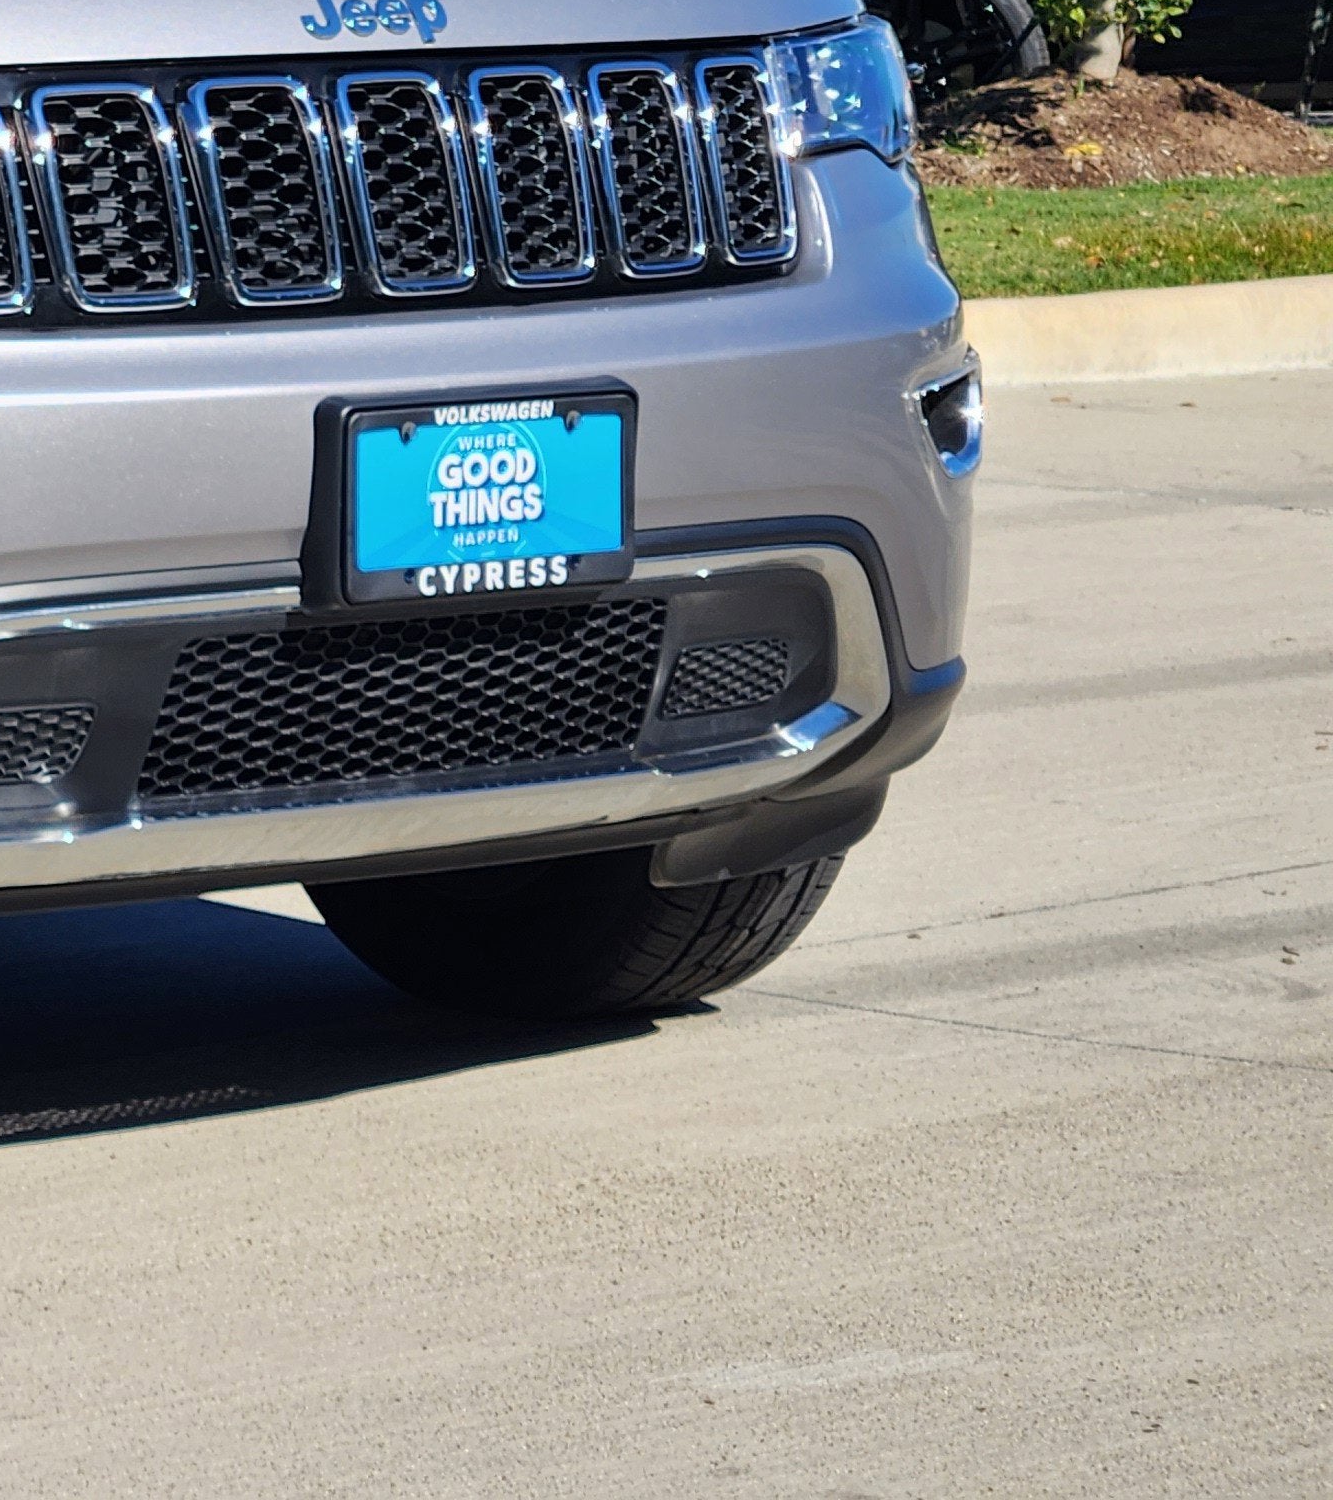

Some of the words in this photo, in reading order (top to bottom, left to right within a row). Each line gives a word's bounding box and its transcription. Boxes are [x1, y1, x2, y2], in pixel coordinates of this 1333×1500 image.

[434, 400, 555, 426] VOLKSWAGEN
[457, 432, 517, 451] WHERE
[437, 447, 537, 489] GOOD
[429, 482, 544, 528] THINGS
[452, 526, 519, 548] HAPPEN
[418, 555, 569, 597] CYPRESS
